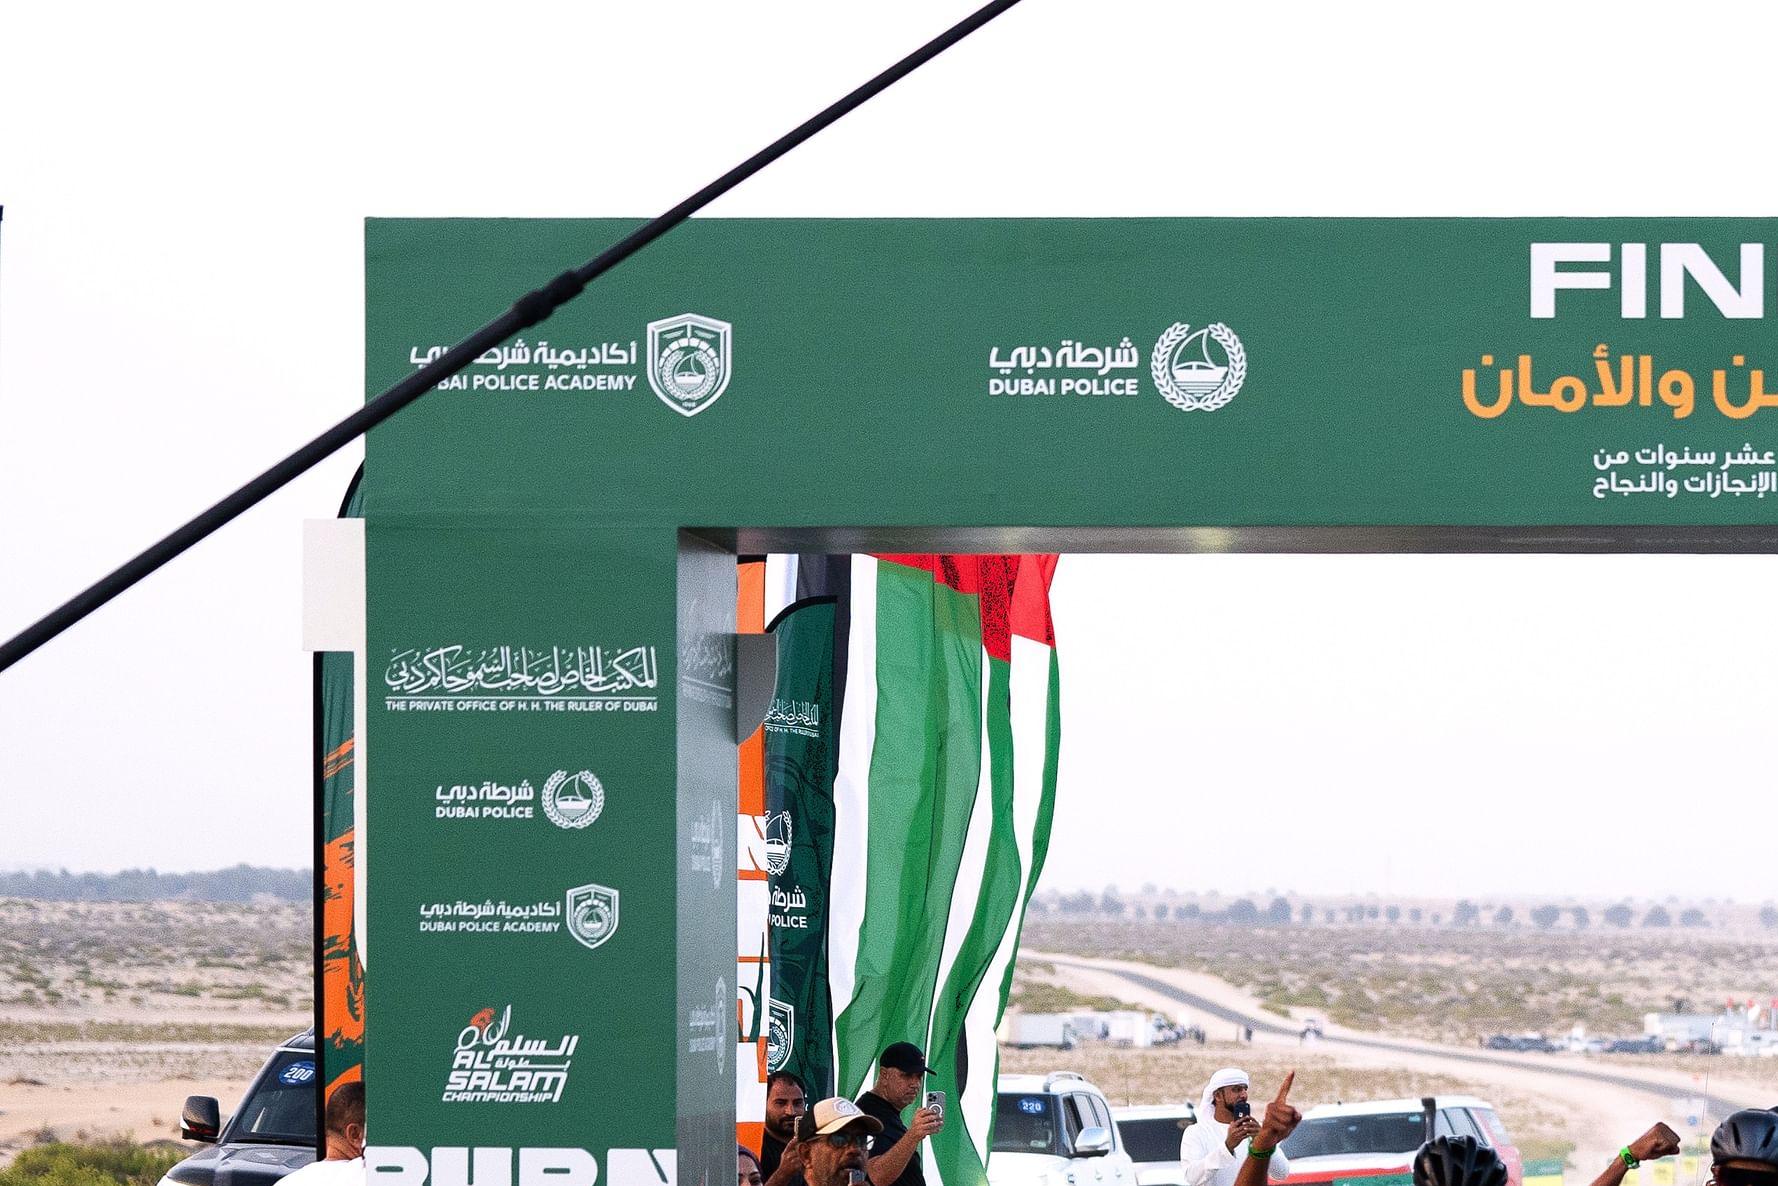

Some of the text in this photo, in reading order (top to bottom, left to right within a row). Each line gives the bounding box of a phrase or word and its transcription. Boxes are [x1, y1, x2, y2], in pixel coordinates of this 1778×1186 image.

[534, 341, 637, 369] أكاديمية
[990, 337, 1138, 375] شرطة دبي
[473, 375, 539, 390] POLICE
[544, 375, 636, 390] ACADEMY
[990, 379, 1138, 395] DUBAI POLICE
[1460, 342, 1696, 420] والأمان
[1594, 443, 1775, 470] عشر سنوات من
[1593, 472, 1777, 498] الإنجازات والنجاح
[386, 701, 657, 711] THE PRIVATE OFFICE OF H. H. THE RULER OF DUBAI
[436, 780, 534, 805] شرطة دبي
[436, 807, 533, 818] DUBAI POLICE
[420, 900, 560, 919] أكاديمية شرطة دبي
[420, 922, 560, 932] DUBAI POLICE ACADEMY
[771, 914, 808, 928] POLICE
[452, 1050, 491, 1069] AL
[284, 1067, 314, 1080] 200
[445, 1070, 568, 1103] SALAM
[442, 1092, 553, 1103] CHAMPIONSHIP
